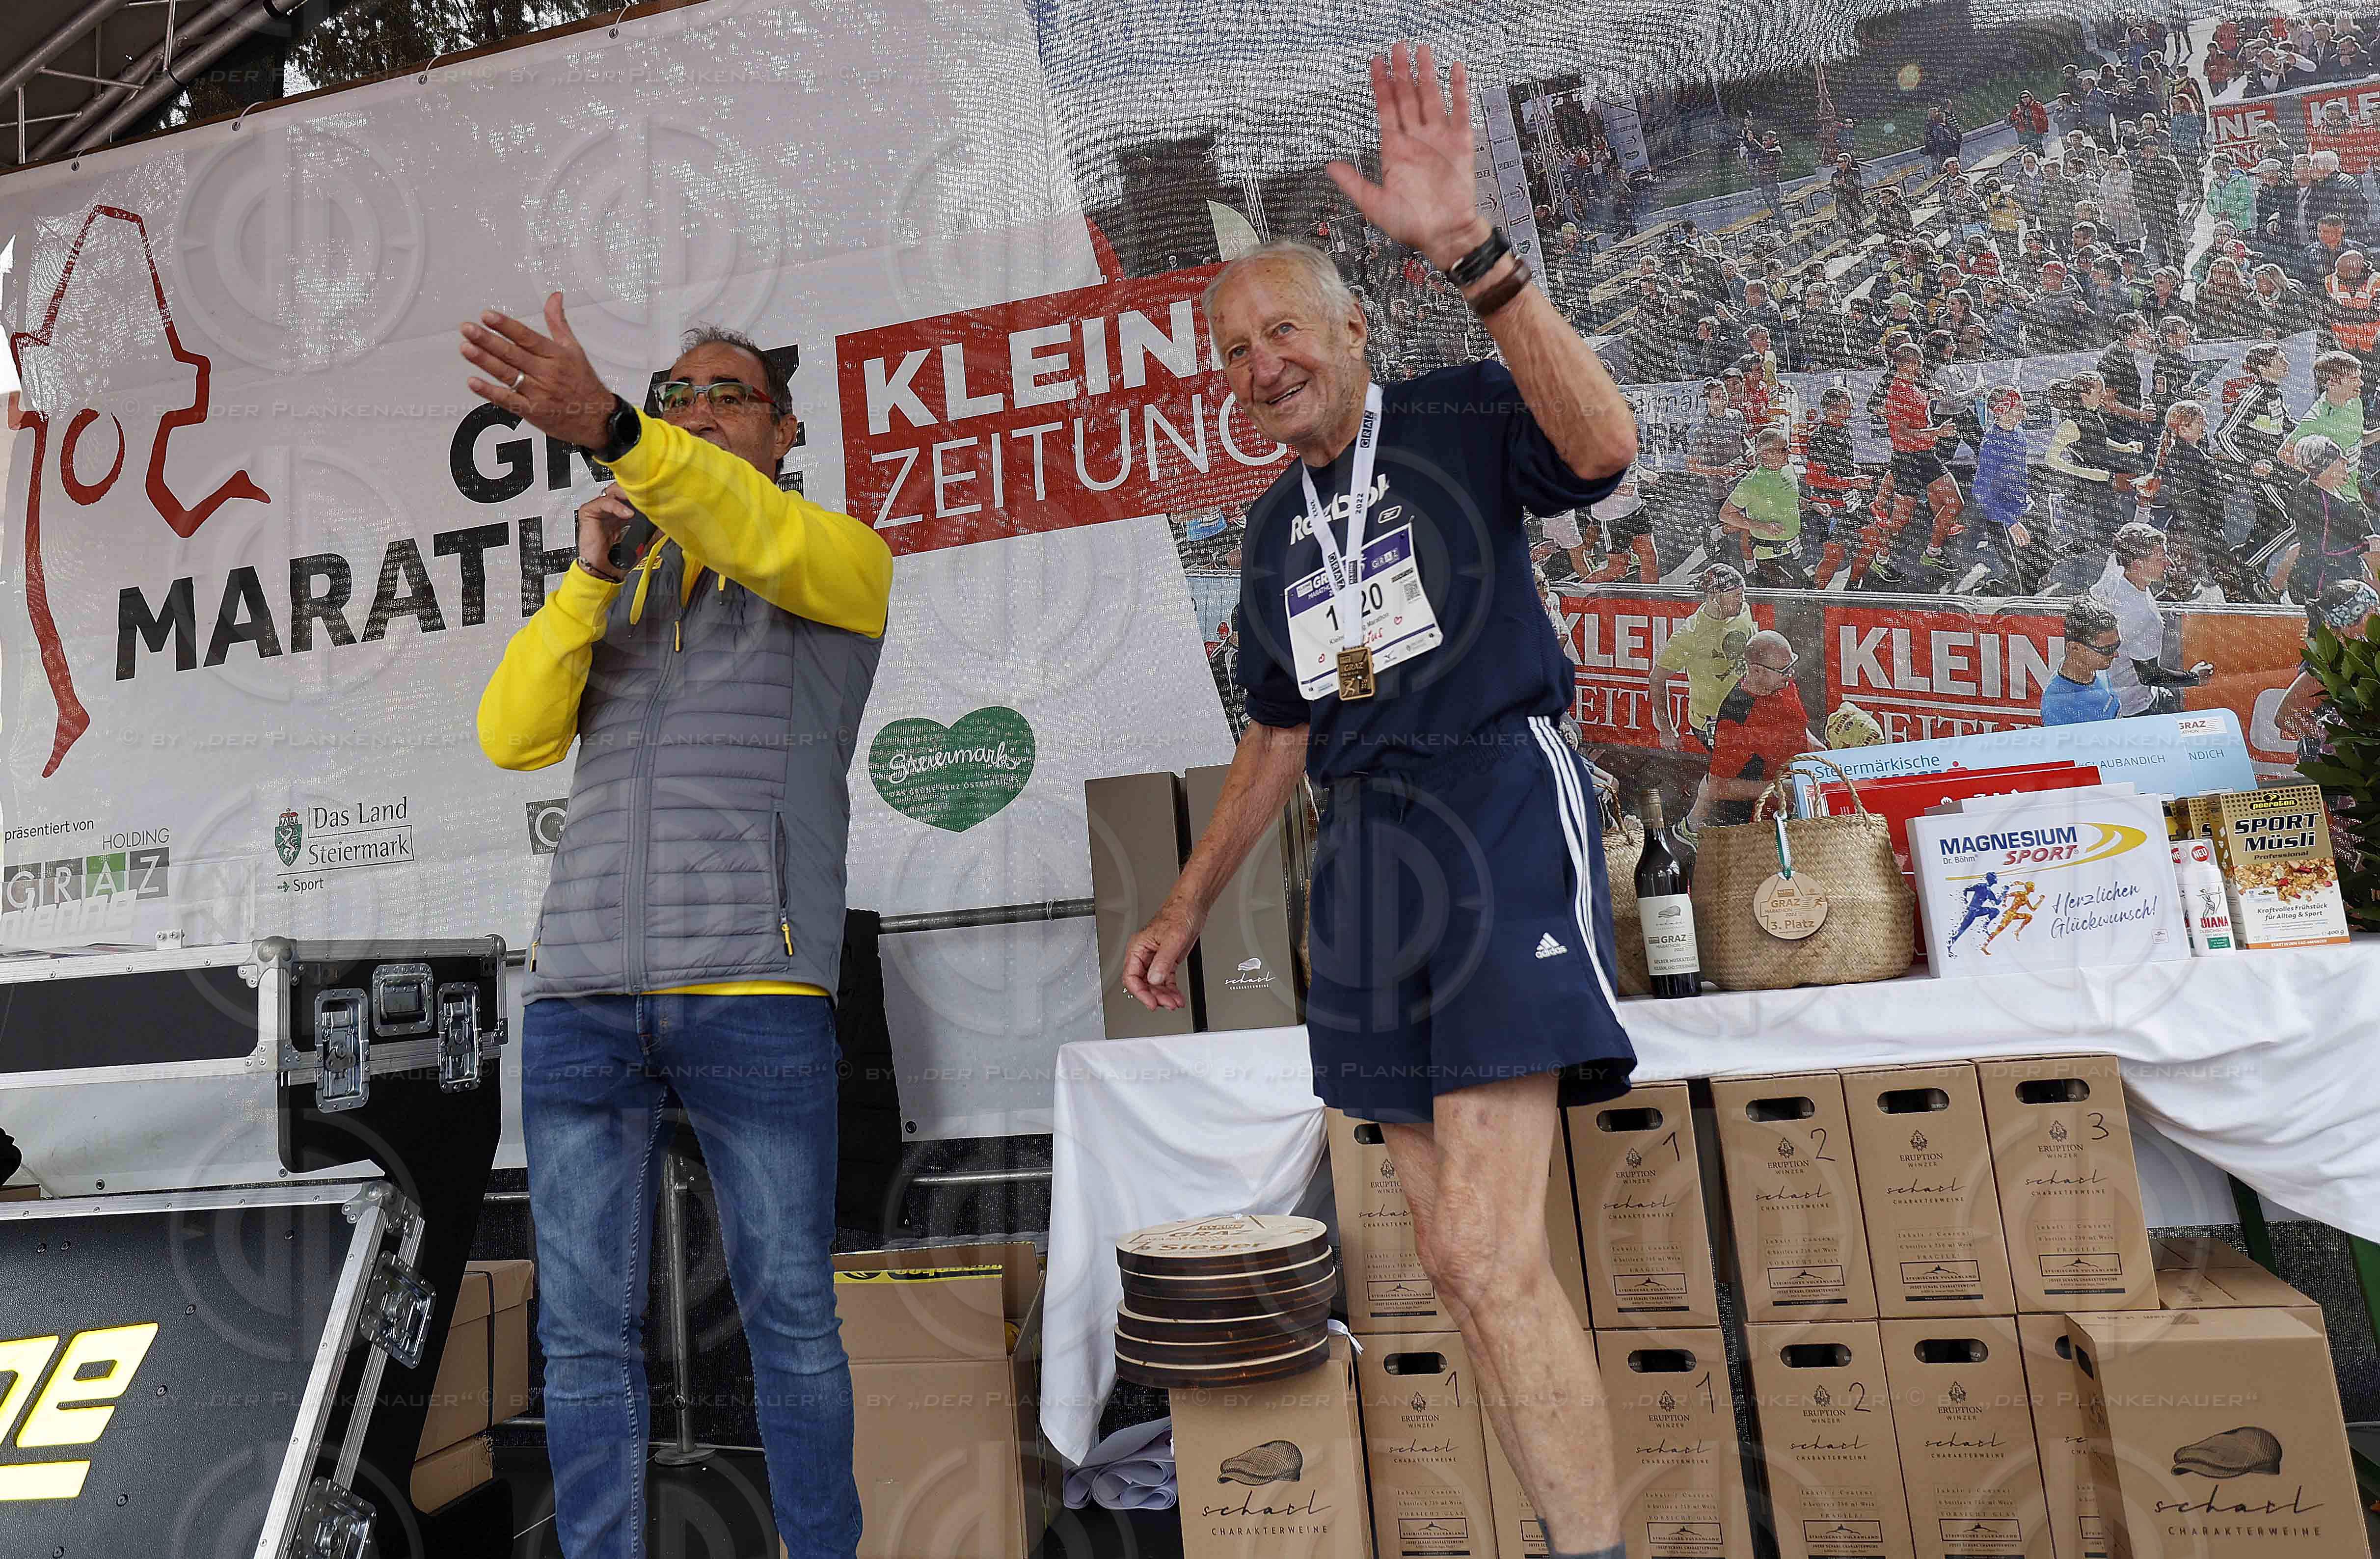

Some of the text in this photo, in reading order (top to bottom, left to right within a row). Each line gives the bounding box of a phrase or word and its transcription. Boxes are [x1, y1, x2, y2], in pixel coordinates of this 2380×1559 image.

[863, 299, 1223, 436] KLEIN
[1360, 410, 1375, 448] GRAZ
[1355, 492, 1364, 514] 2022
[1328, 552, 1346, 590] GRAZ
[1371, 550, 1399, 570] GRAZ
[116, 515, 579, 681] MARATH
[1326, 582, 1383, 632] 120
[1344, 662, 1364, 671] GRAZ
[1839, 624, 2064, 700] KLEIN
[889, 741, 1020, 784] Steiermark
[1816, 755, 1940, 779] Steiermärkische
[909, 786, 936, 796] GRÜNE
[313, 796, 407, 829] Das Land
[2252, 799, 2295, 810] peeroton
[4, 819, 94, 844] präsentiert von
[2234, 812, 2320, 835] SPORT
[102, 828, 170, 850] HOLDING
[309, 834, 409, 865] Steiermark
[1940, 825, 2078, 856] MAGNESIUM
[2243, 831, 2316, 853] Müsli
[1943, 856, 1952, 865] Dr.
[2192, 847, 2208, 859] NEU
[2253, 850, 2309, 860] Professional
[6, 854, 161, 909] GRAZ
[293, 878, 324, 894] Sport
[1771, 898, 1800, 908] GRAZ
[2052, 880, 2141, 917] Herzlichen
[2295, 903, 2328, 911] Frühstück
[1771, 919, 1815, 930] 3. Platz
[2051, 895, 2158, 940] Glückwunsch!
[2199, 916, 2229, 928] DIANA
[2304, 910, 2323, 918] Sport
[1661, 935, 1687, 943] GRAZ
[2087, 1112, 2109, 1140] 3
[1663, 1131, 1680, 1161] 1
[1811, 1128, 1836, 1161] 2
[1767, 1160, 1809, 1169] ERUPTION
[1900, 1153, 1944, 1162] ERUPTION
[1615, 1170, 1656, 1179] ERUPTION
[1158, 1240, 1268, 1252] Sieger
[1445, 1371, 1460, 1408] 1
[1695, 1371, 1714, 1414] 1
[1849, 1382, 1871, 1412] 2
[1202, 1490, 1332, 1518] scharl
[2153, 1484, 2324, 1514] scharl
[1211, 1525, 1328, 1536] CHARAKTERWEINE
[2167, 1525, 2322, 1537] CHARAKTERWEINE
